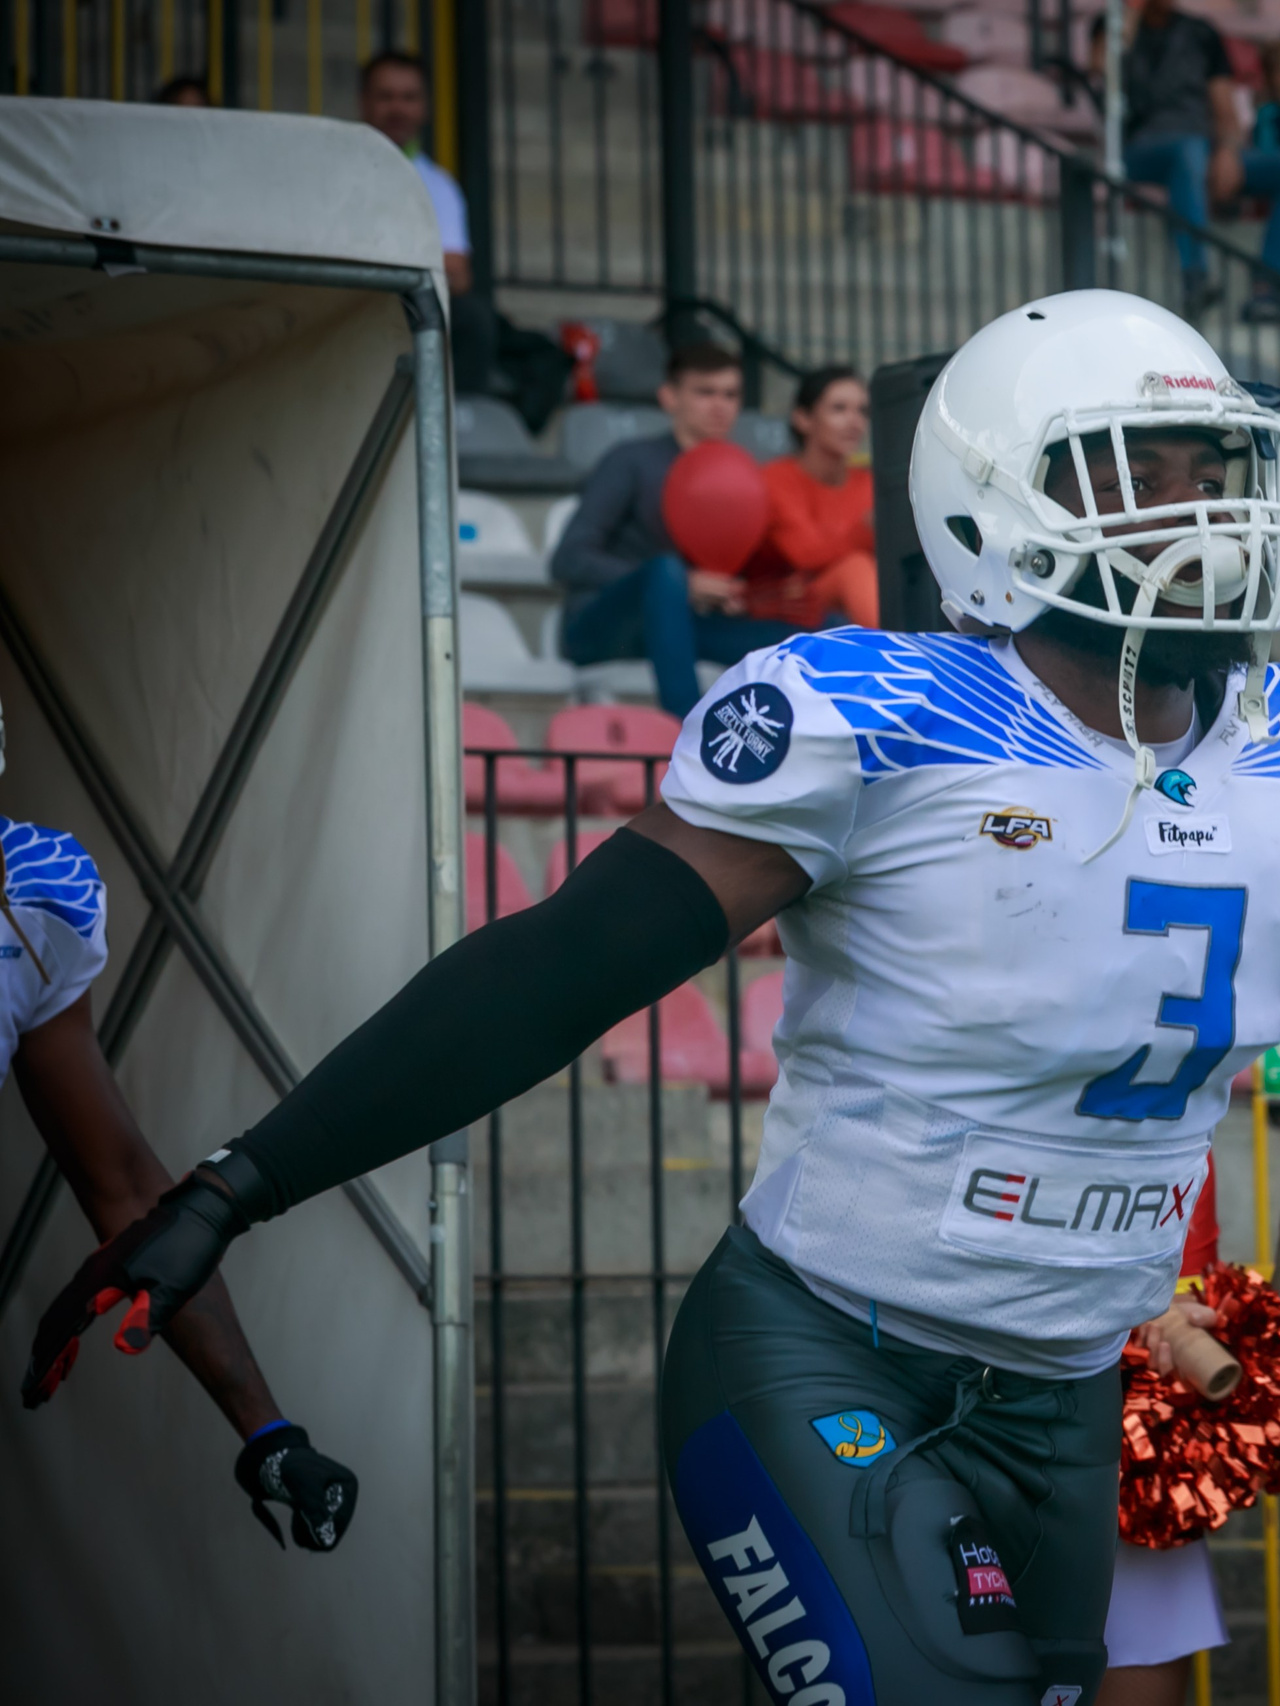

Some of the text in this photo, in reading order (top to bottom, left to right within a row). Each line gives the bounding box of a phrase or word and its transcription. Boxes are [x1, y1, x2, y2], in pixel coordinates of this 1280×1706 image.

[1162, 374, 1216, 391] Riddell
[717, 704, 772, 758] SZCZYT FORMY
[1033, 681, 1104, 748] FLY HIGH
[1219, 719, 1240, 746] FLY
[983, 815, 1049, 838] LFA
[1076, 877, 1249, 1121] 3
[963, 1167, 1195, 1232] ELMAX
